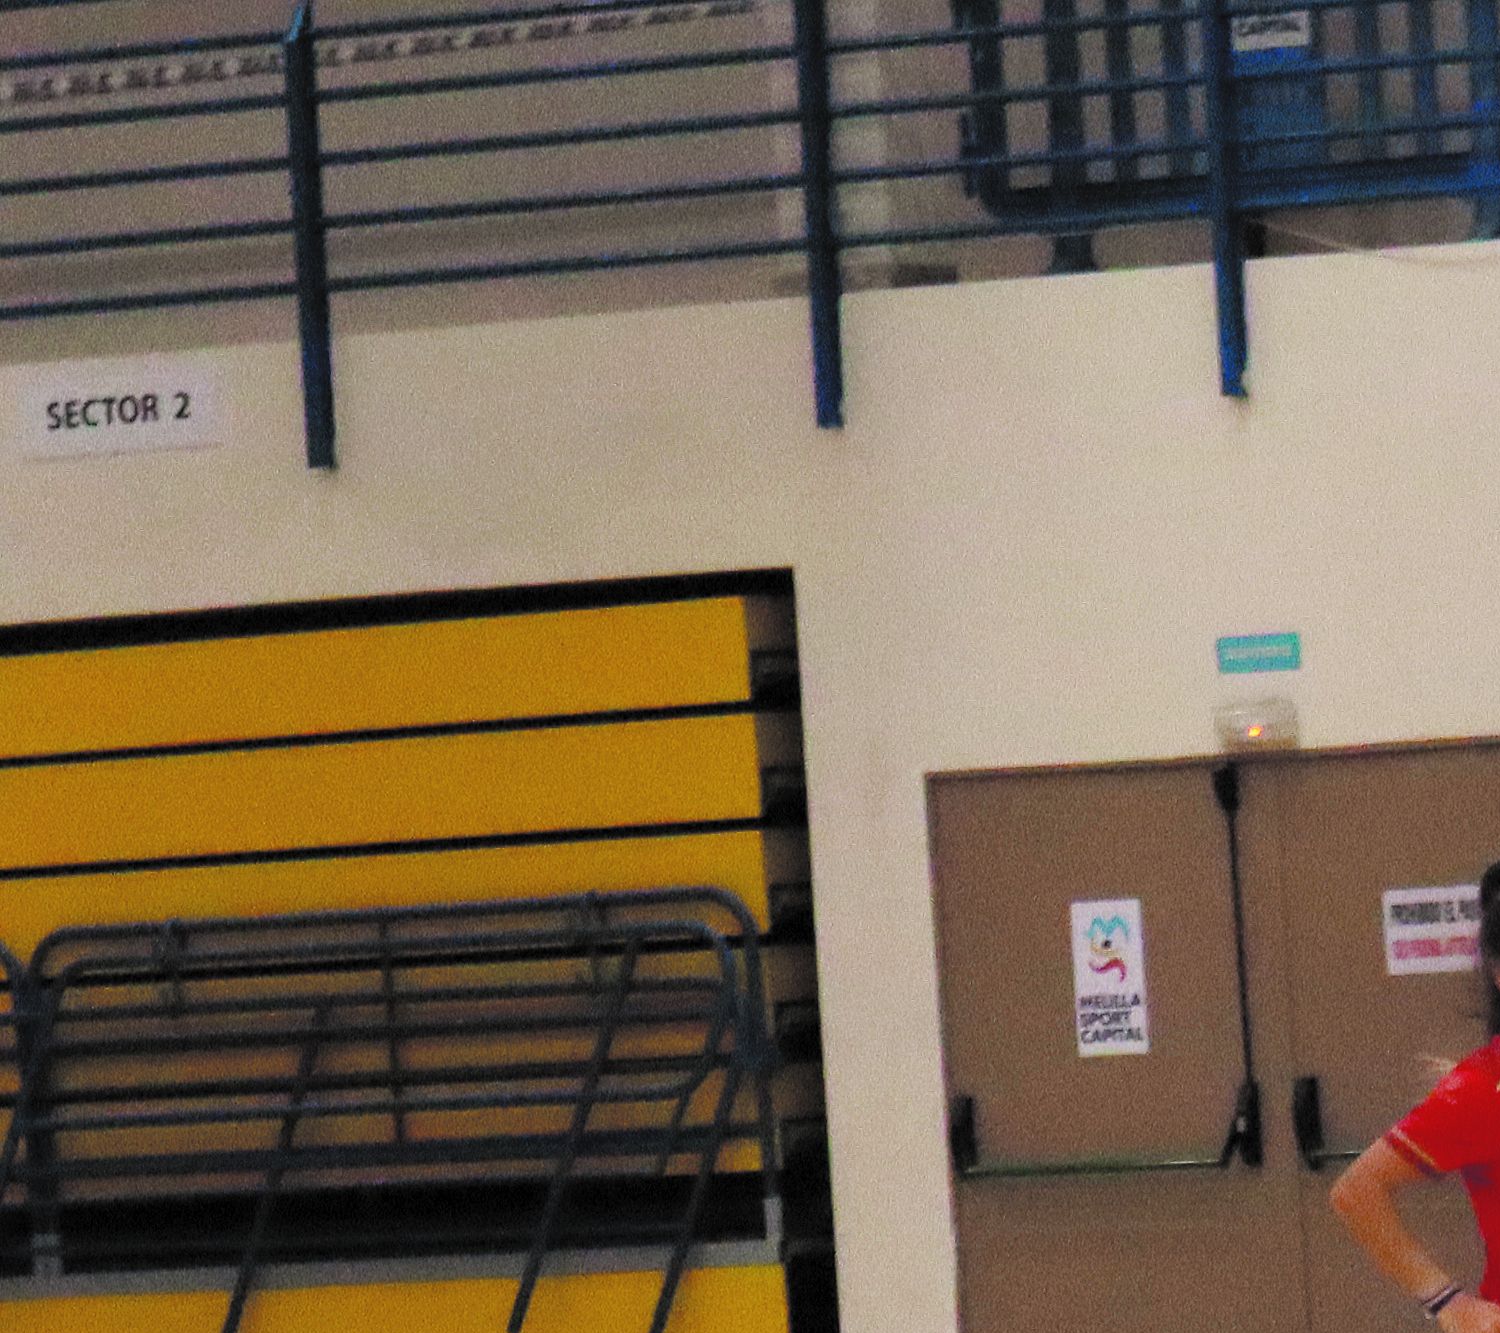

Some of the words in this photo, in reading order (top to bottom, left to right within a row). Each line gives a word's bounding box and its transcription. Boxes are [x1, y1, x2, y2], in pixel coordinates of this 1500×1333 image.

[45, 392, 160, 431] SECTOR
[174, 390, 191, 421] 2
[1081, 1028, 1143, 1044] CAPITAL
